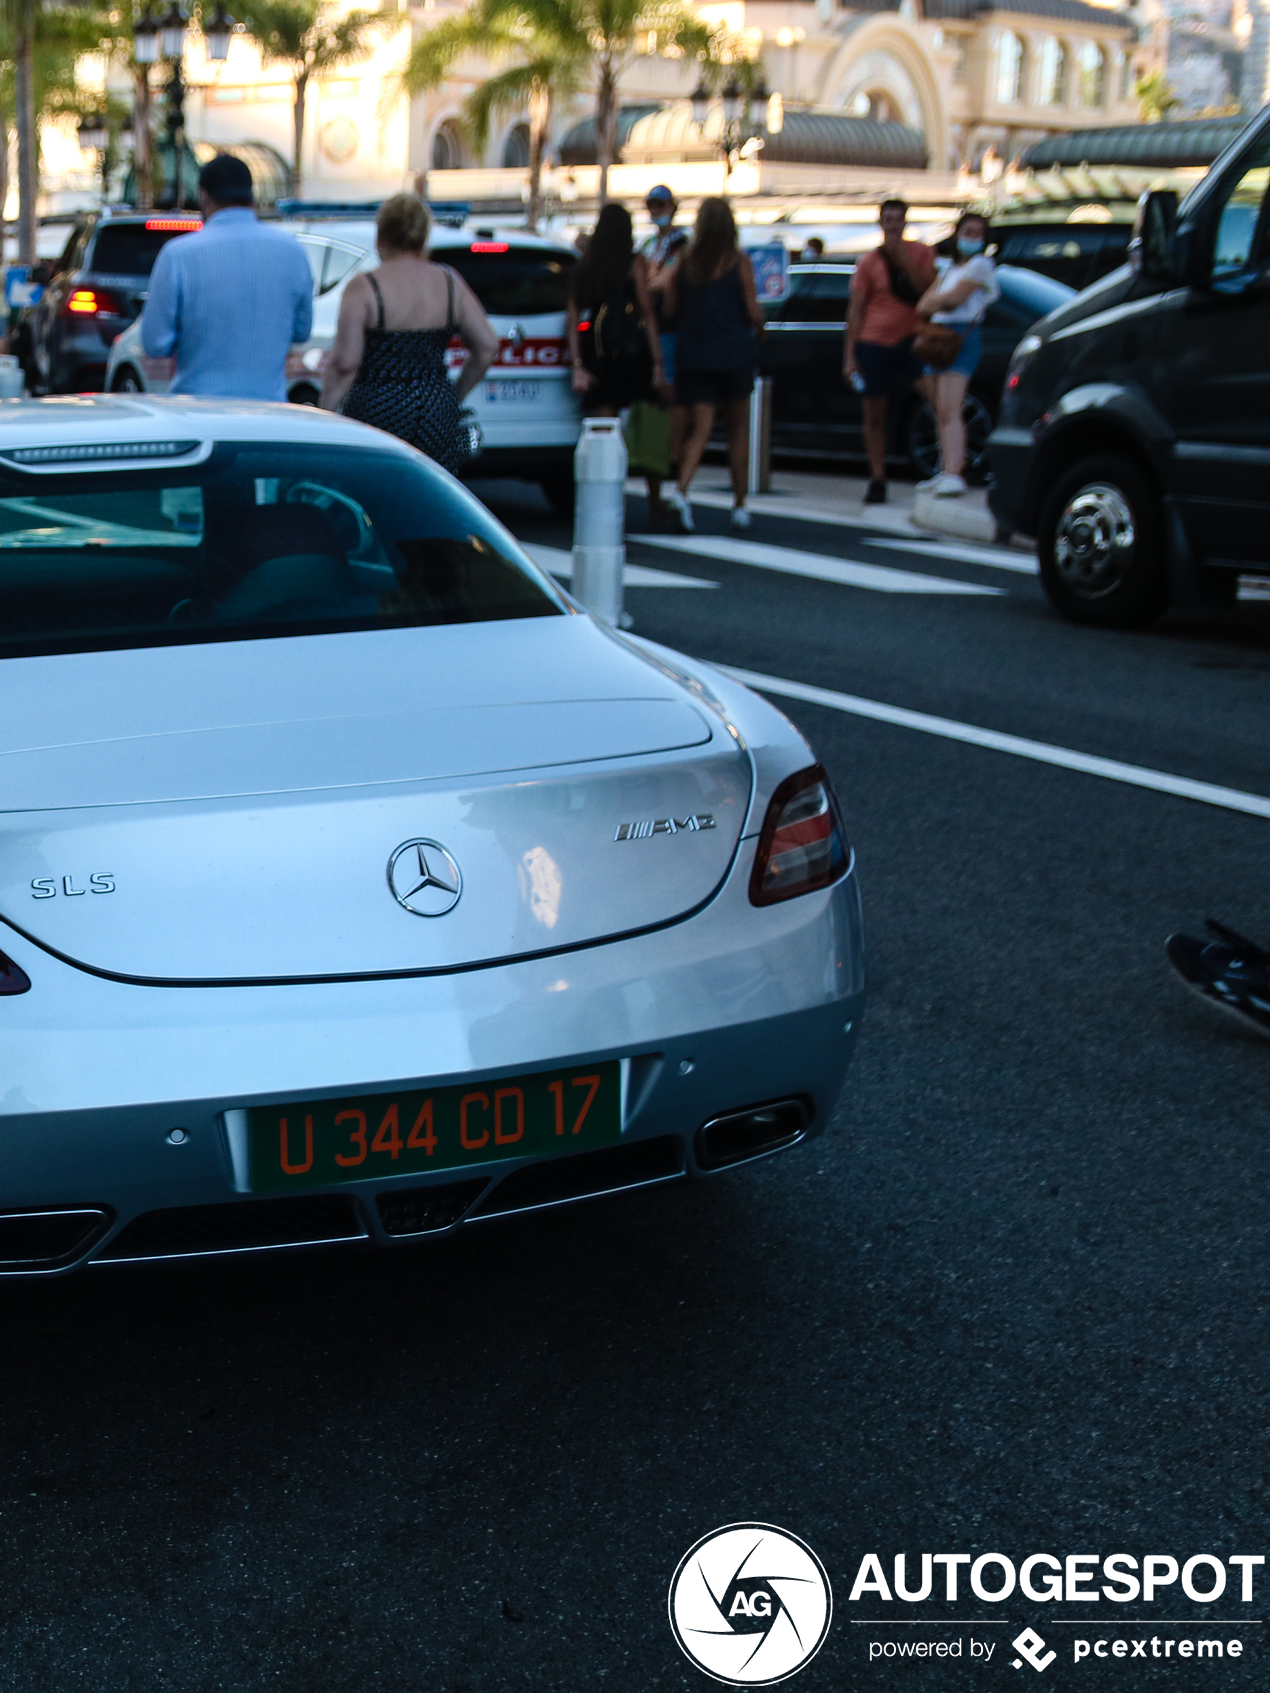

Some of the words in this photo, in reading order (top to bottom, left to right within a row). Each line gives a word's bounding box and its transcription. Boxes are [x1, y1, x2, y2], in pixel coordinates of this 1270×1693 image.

[443, 345, 568, 366] PLIC
[643, 813, 717, 838] AMG
[31, 872, 116, 899] SLS
[279, 1114, 314, 1176] U
[333, 1098, 439, 1167] 344
[459, 1086, 525, 1150] CD
[547, 1073, 602, 1136] 17
